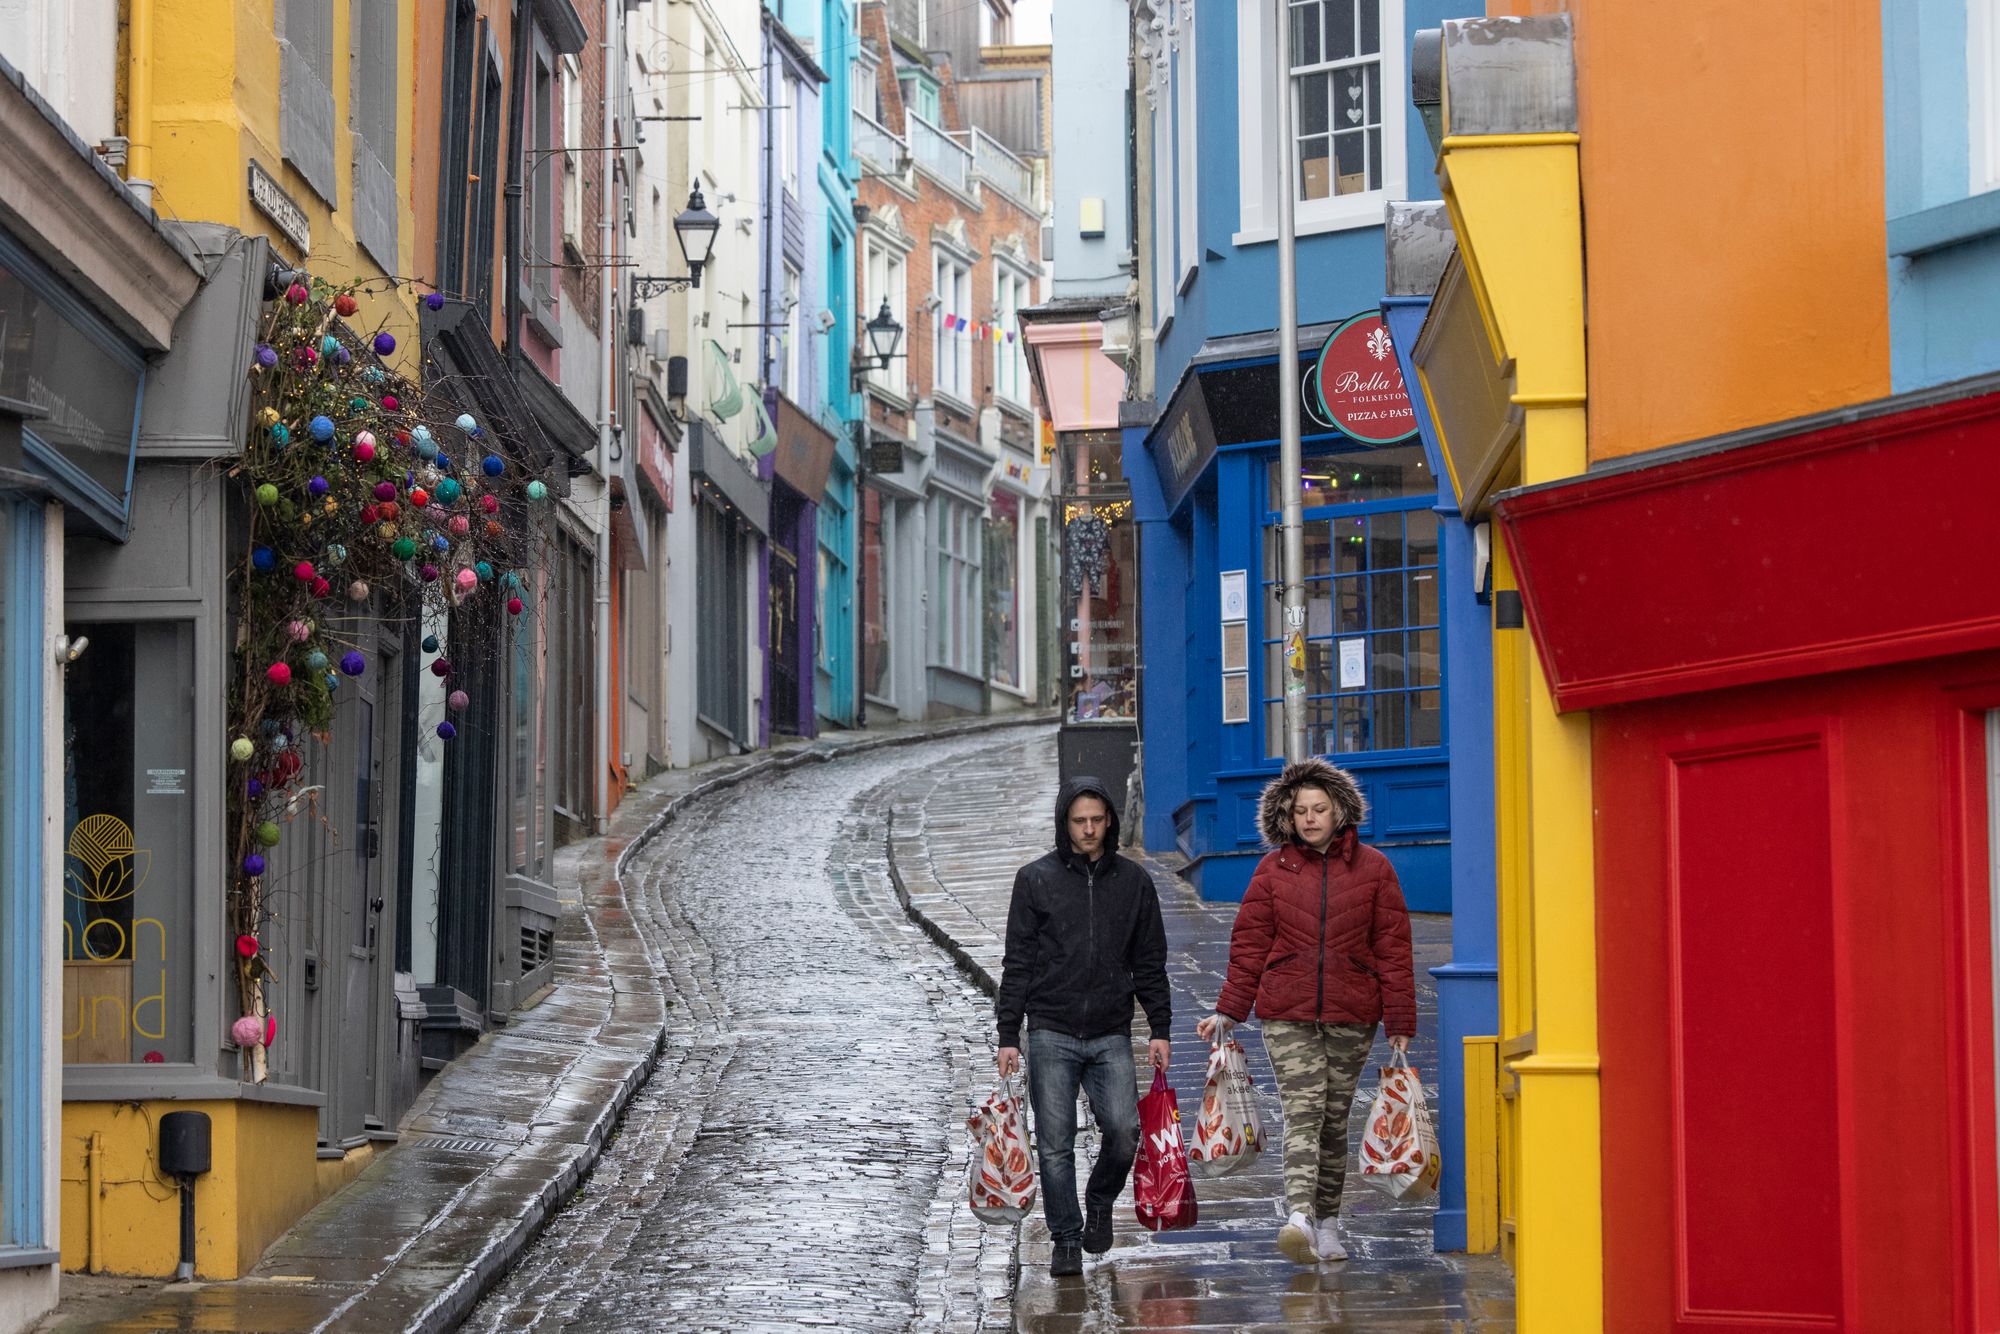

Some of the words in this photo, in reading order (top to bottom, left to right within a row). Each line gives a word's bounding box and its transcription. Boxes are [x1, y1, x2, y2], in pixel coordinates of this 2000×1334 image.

[256, 170, 266, 204] THE
[267, 182, 277, 214] OLD
[290, 207, 305, 244] STREET
[1334, 370, 1391, 394] Bella
[1347, 411, 1378, 421] PIZZA
[1380, 410, 1387, 418] &
